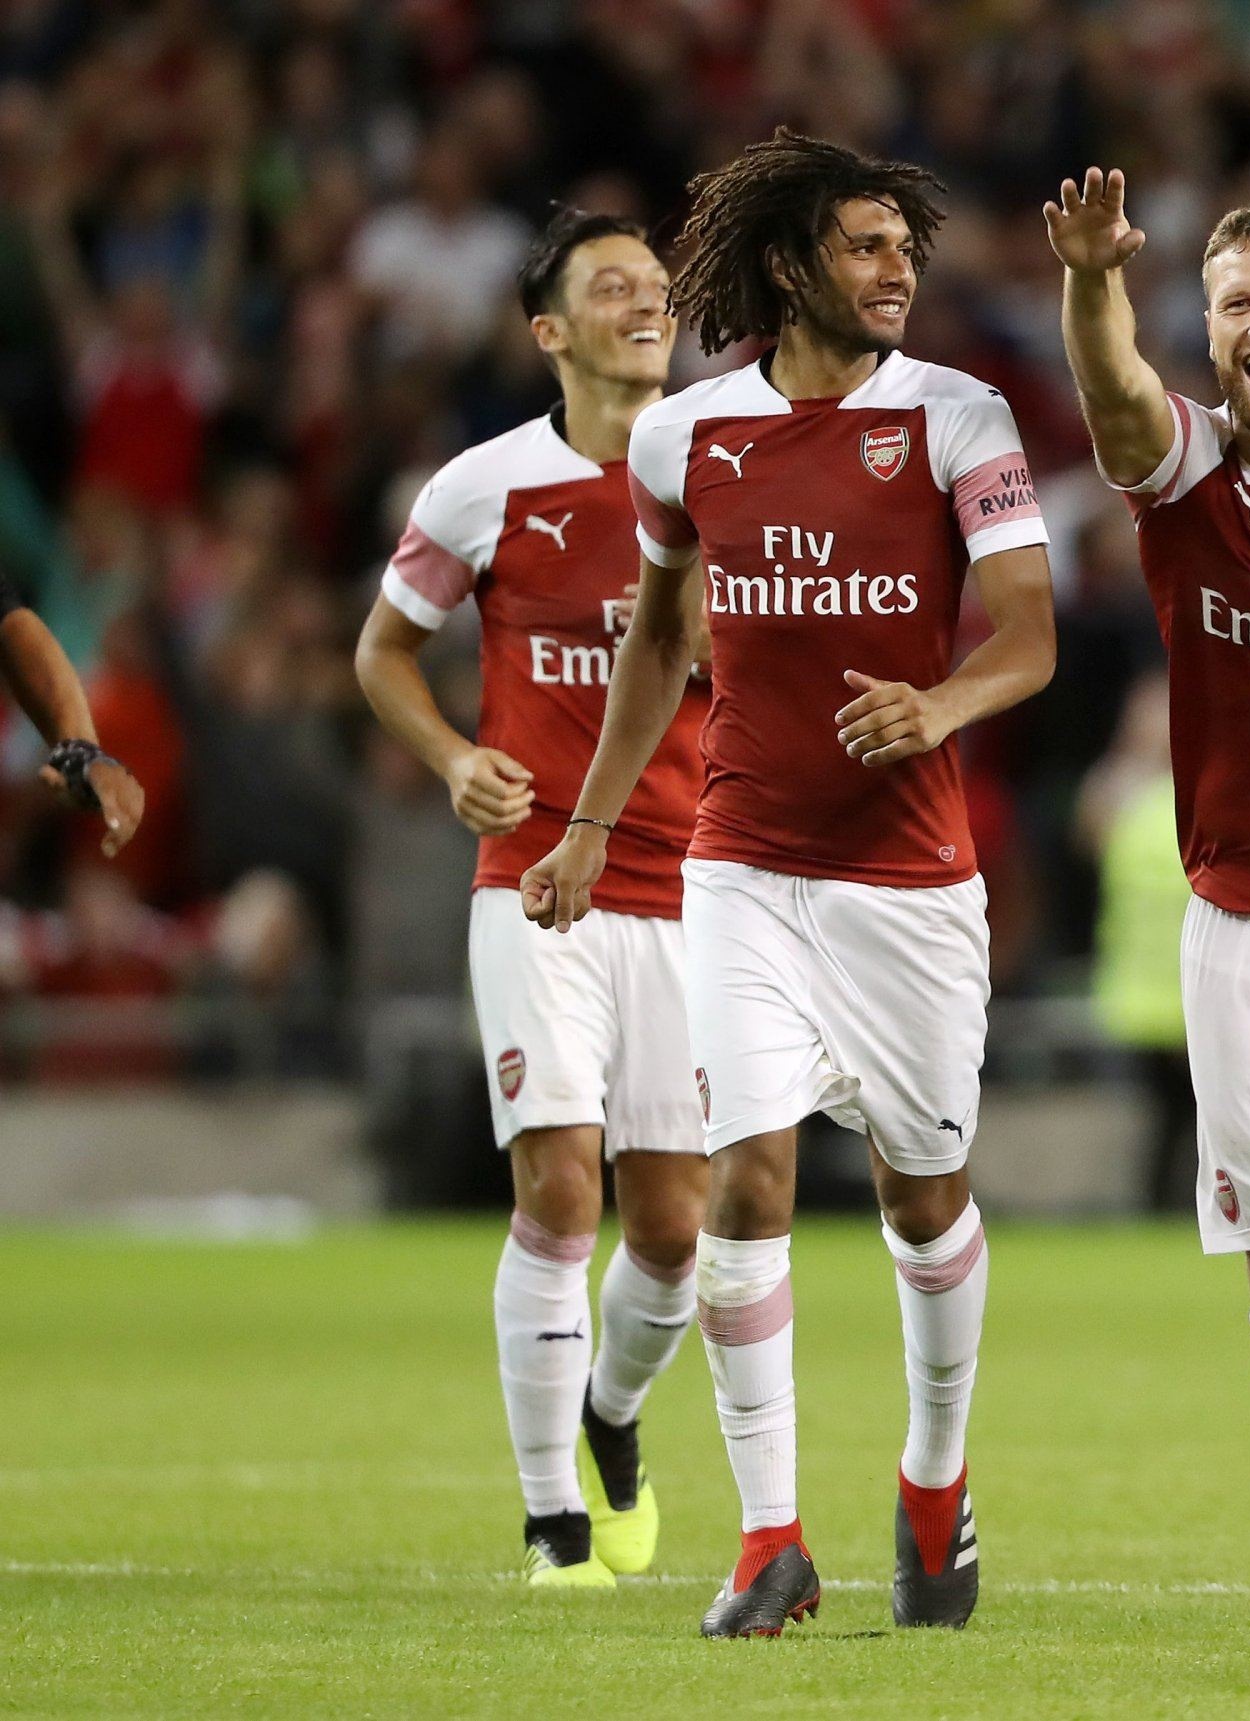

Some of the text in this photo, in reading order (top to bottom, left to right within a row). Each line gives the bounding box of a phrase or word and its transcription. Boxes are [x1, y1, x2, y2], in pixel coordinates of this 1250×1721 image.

[867, 433, 903, 447] Arsenal
[979, 488, 1039, 517] RWAN
[762, 525, 835, 567] Fly
[707, 563, 920, 616] Emirates
